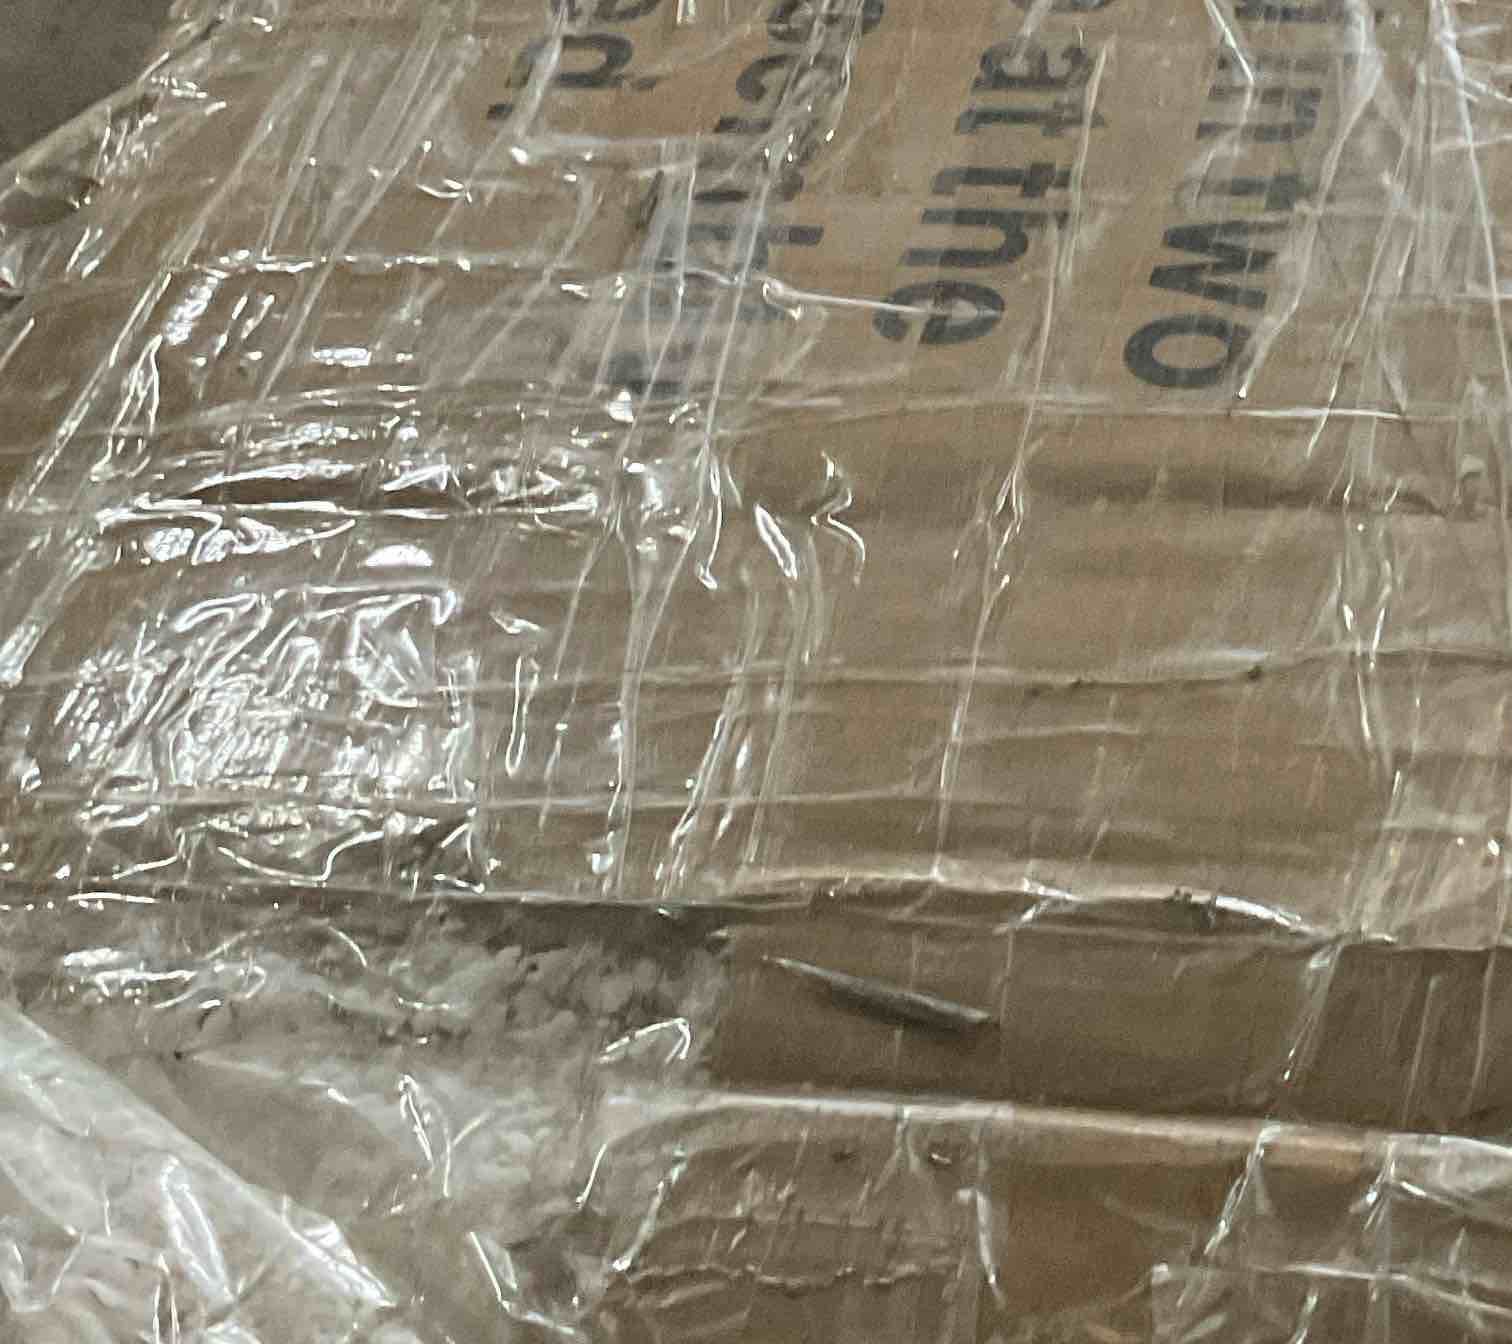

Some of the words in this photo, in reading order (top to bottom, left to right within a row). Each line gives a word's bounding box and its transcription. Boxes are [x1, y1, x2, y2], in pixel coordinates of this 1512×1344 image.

[955, 43, 1105, 135] at
[872, 159, 1075, 346] the
[1122, 171, 1305, 389] two
